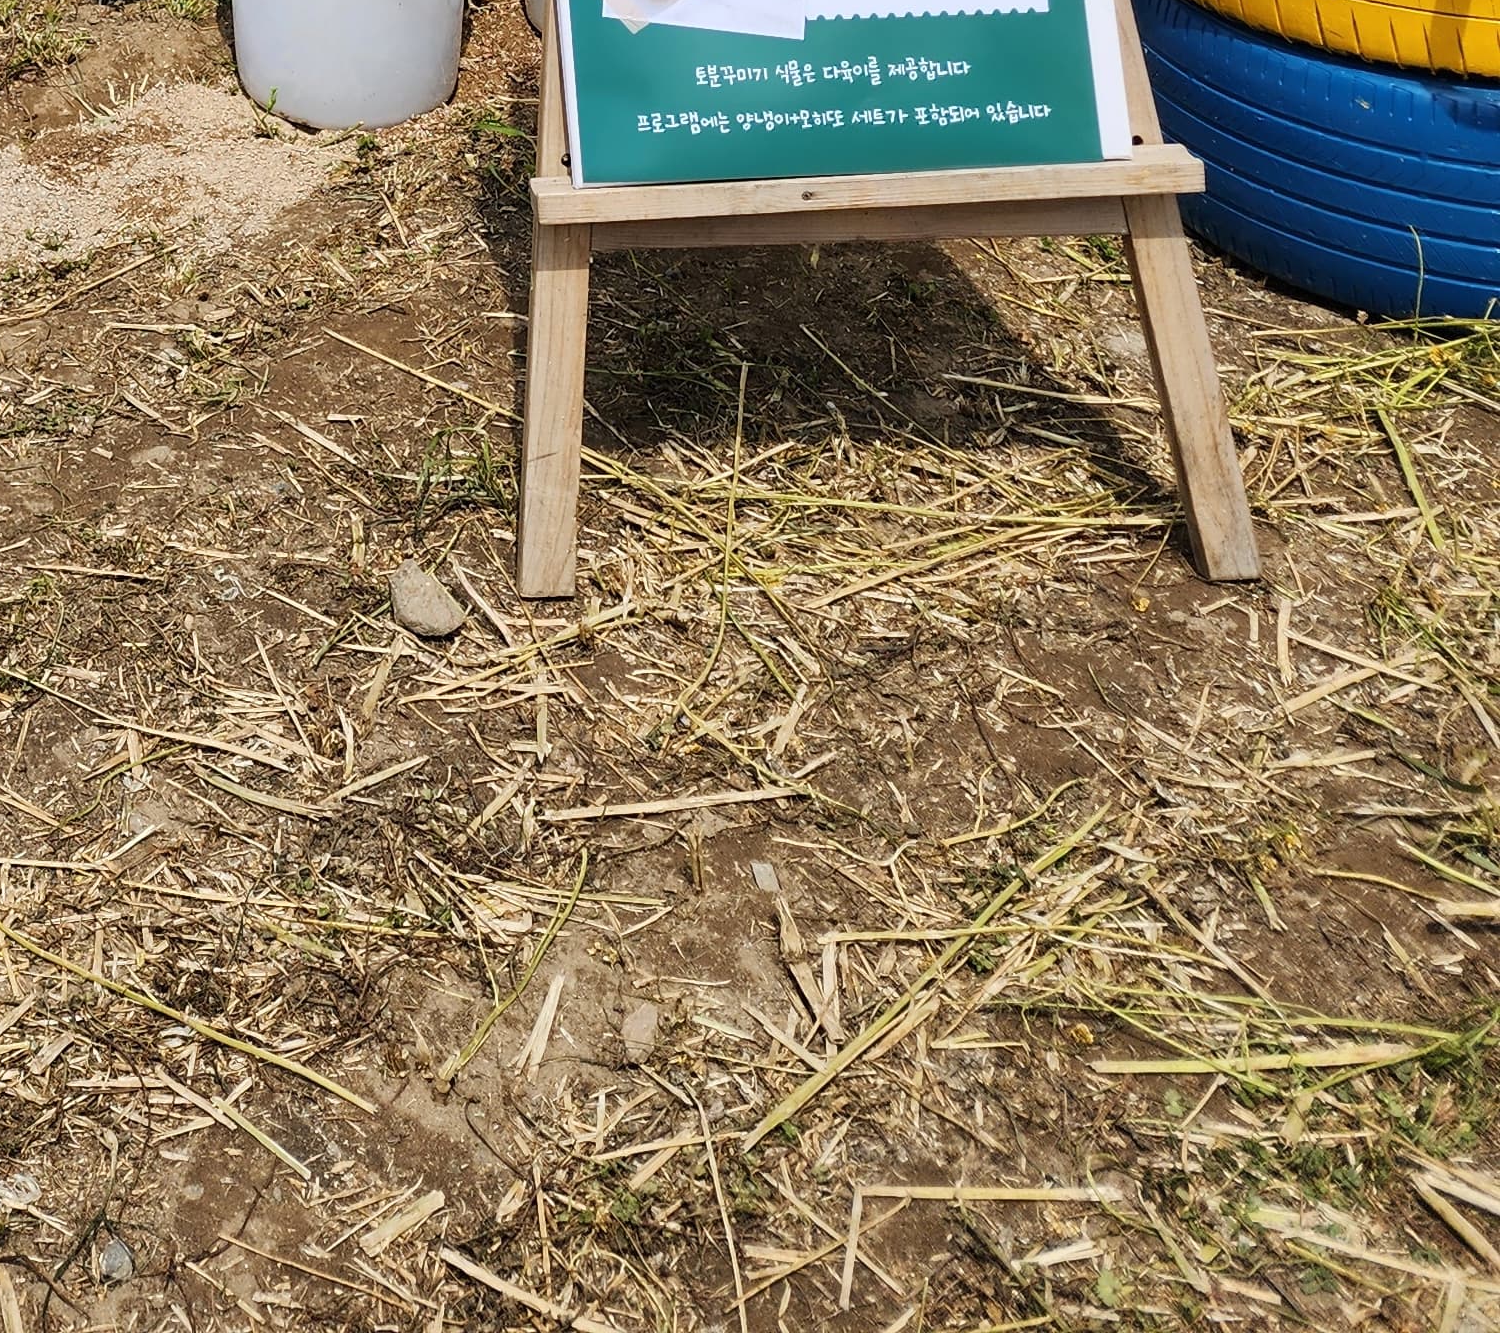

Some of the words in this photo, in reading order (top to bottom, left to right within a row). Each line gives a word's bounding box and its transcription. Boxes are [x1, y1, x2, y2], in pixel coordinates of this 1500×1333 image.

[695, 64, 769, 88] 토분꾸미기
[775, 59, 816, 87] 식물은
[822, 56, 882, 85] 다육이를
[887, 57, 972, 81] 제공합니다
[636, 111, 731, 135] 프로그램에는
[851, 107, 909, 126] 세트가
[914, 103, 980, 127] 포함되어
[986, 100, 1053, 124] 있습니다
